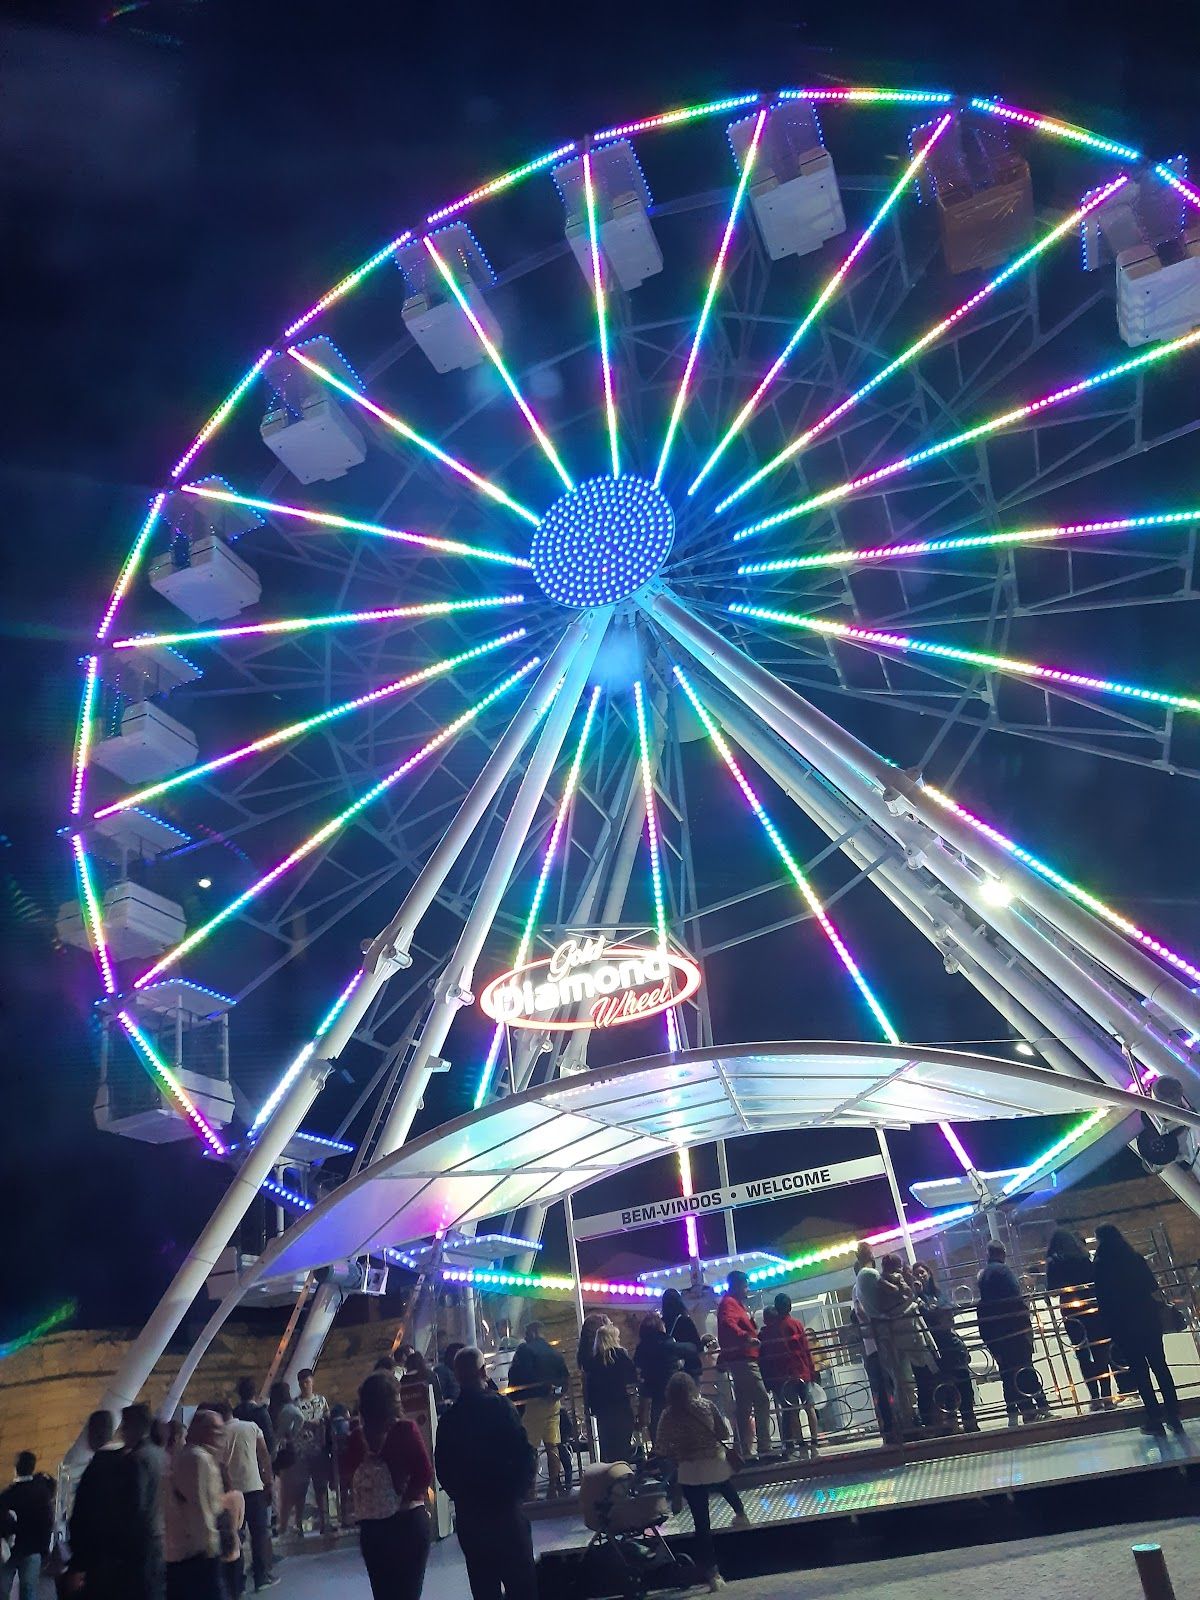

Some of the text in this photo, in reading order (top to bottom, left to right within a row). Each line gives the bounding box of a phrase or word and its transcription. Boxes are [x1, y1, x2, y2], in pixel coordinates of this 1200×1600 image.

[547, 935, 606, 983] Gold
[494, 957, 670, 1020] Diamond
[588, 976, 671, 1029] Wheel
[622, 1169, 831, 1225] BEM-VINDOS WELCOME
